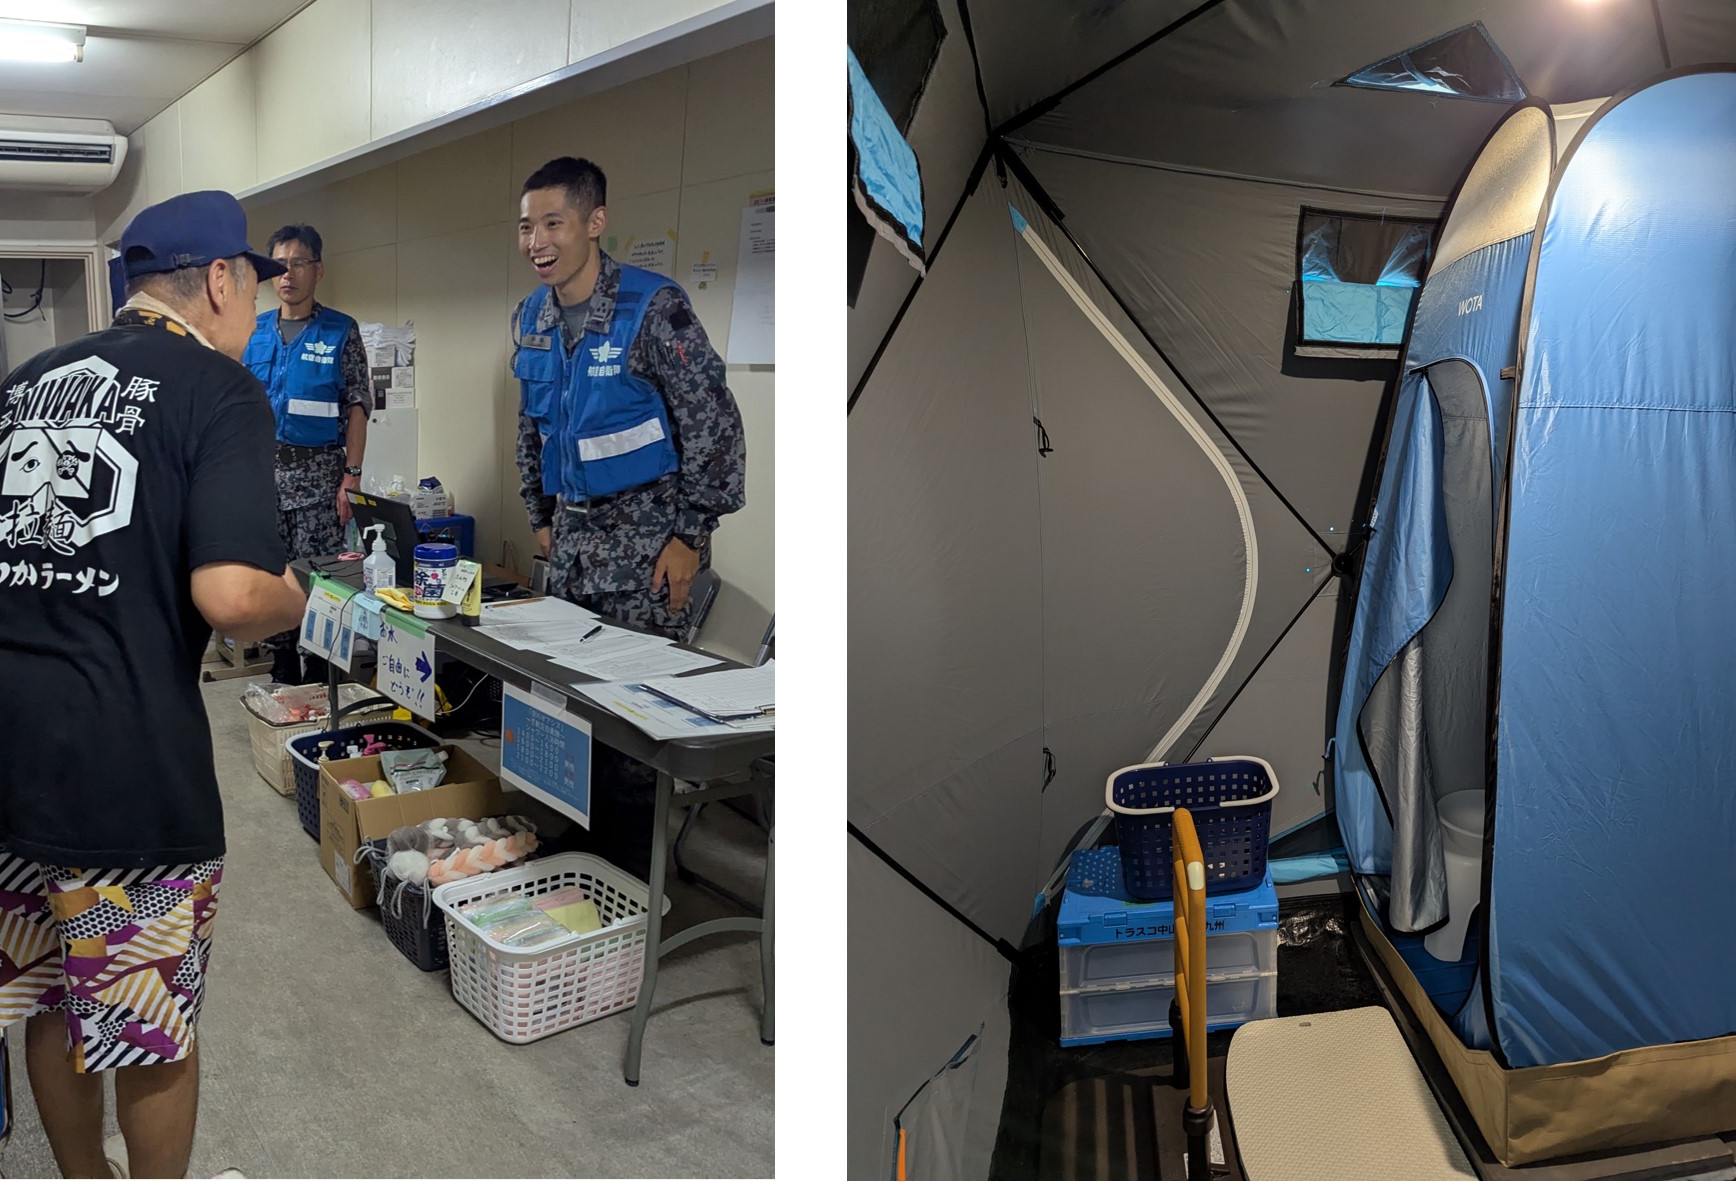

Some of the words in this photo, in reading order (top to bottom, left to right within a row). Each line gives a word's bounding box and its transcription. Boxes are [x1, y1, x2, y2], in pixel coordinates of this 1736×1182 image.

[1458, 294, 1483, 316] WOTA
[14, 374, 116, 424] NIWAKA
[115, 376, 160, 435] 豚骨
[380, 621, 398, 643] お水
[382, 654, 410, 678] ご自由に
